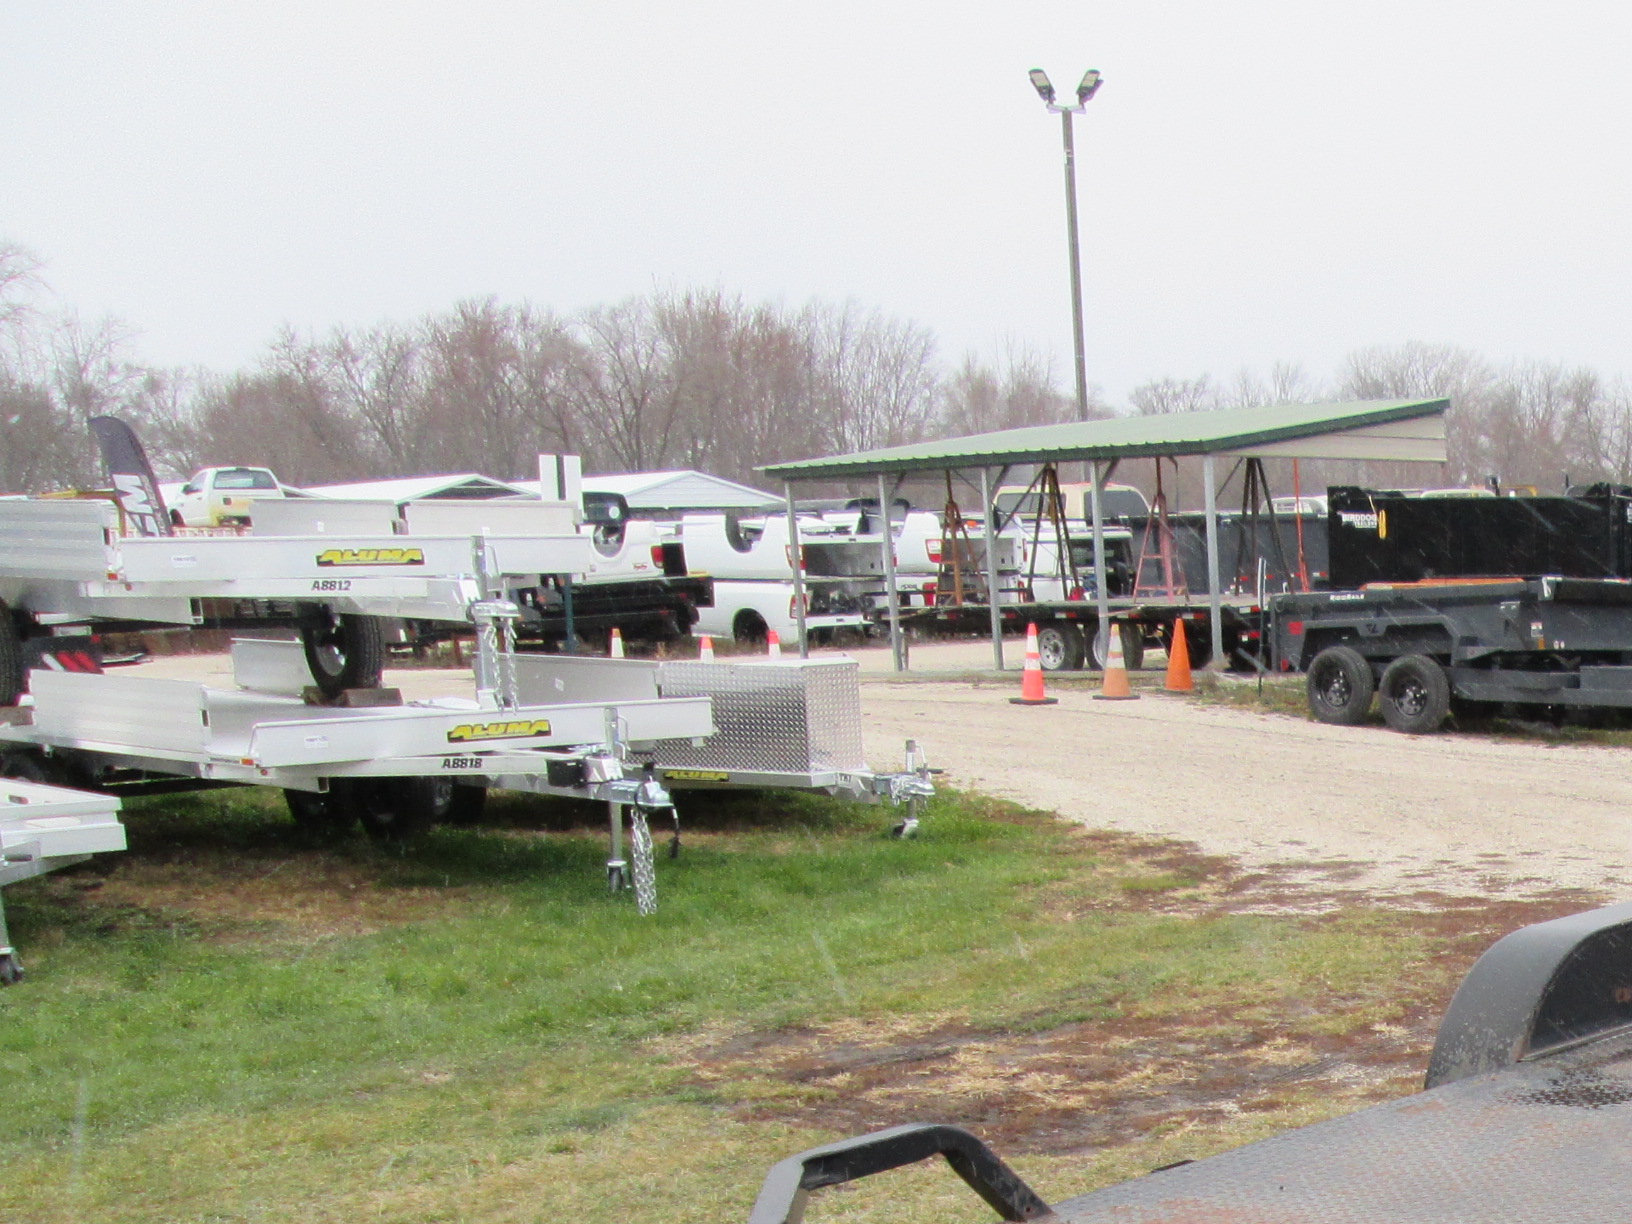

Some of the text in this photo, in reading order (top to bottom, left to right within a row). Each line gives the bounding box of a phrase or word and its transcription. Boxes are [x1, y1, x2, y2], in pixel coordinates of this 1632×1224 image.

[319, 549, 423, 565] ALUMA
[312, 580, 351, 591] A8812
[449, 720, 550, 740] ALUMA
[442, 758, 482, 768] A8818
